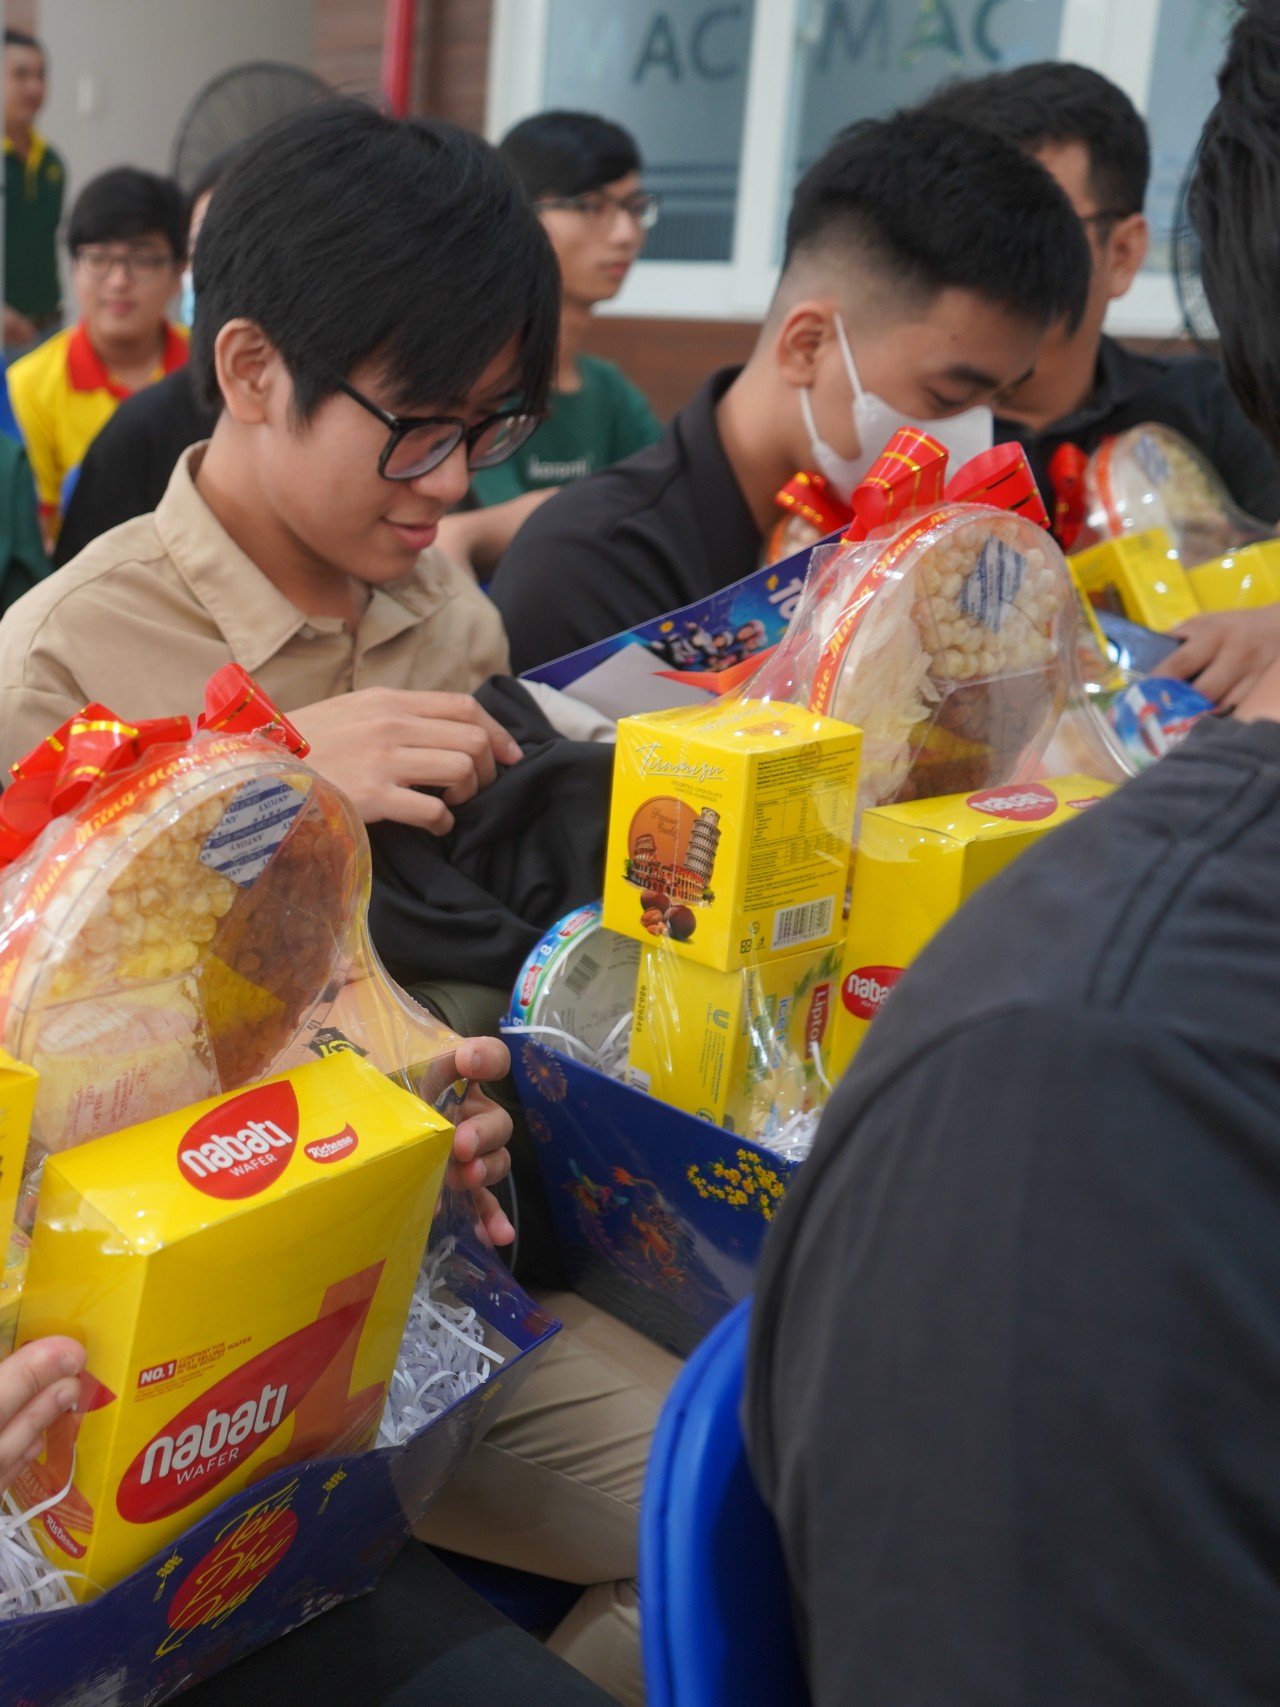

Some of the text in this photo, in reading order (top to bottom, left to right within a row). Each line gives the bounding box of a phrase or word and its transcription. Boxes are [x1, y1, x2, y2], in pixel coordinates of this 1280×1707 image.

[848, 973, 894, 1005] naba
[181, 1120, 293, 1178] nabati
[308, 1136, 354, 1159] Richeese
[229, 1153, 277, 1177] WAFER
[140, 1367, 166, 1385] NO.
[167, 1362, 175, 1376] 1
[140, 1384, 288, 1485] nabati
[177, 1447, 240, 1486] WAFER
